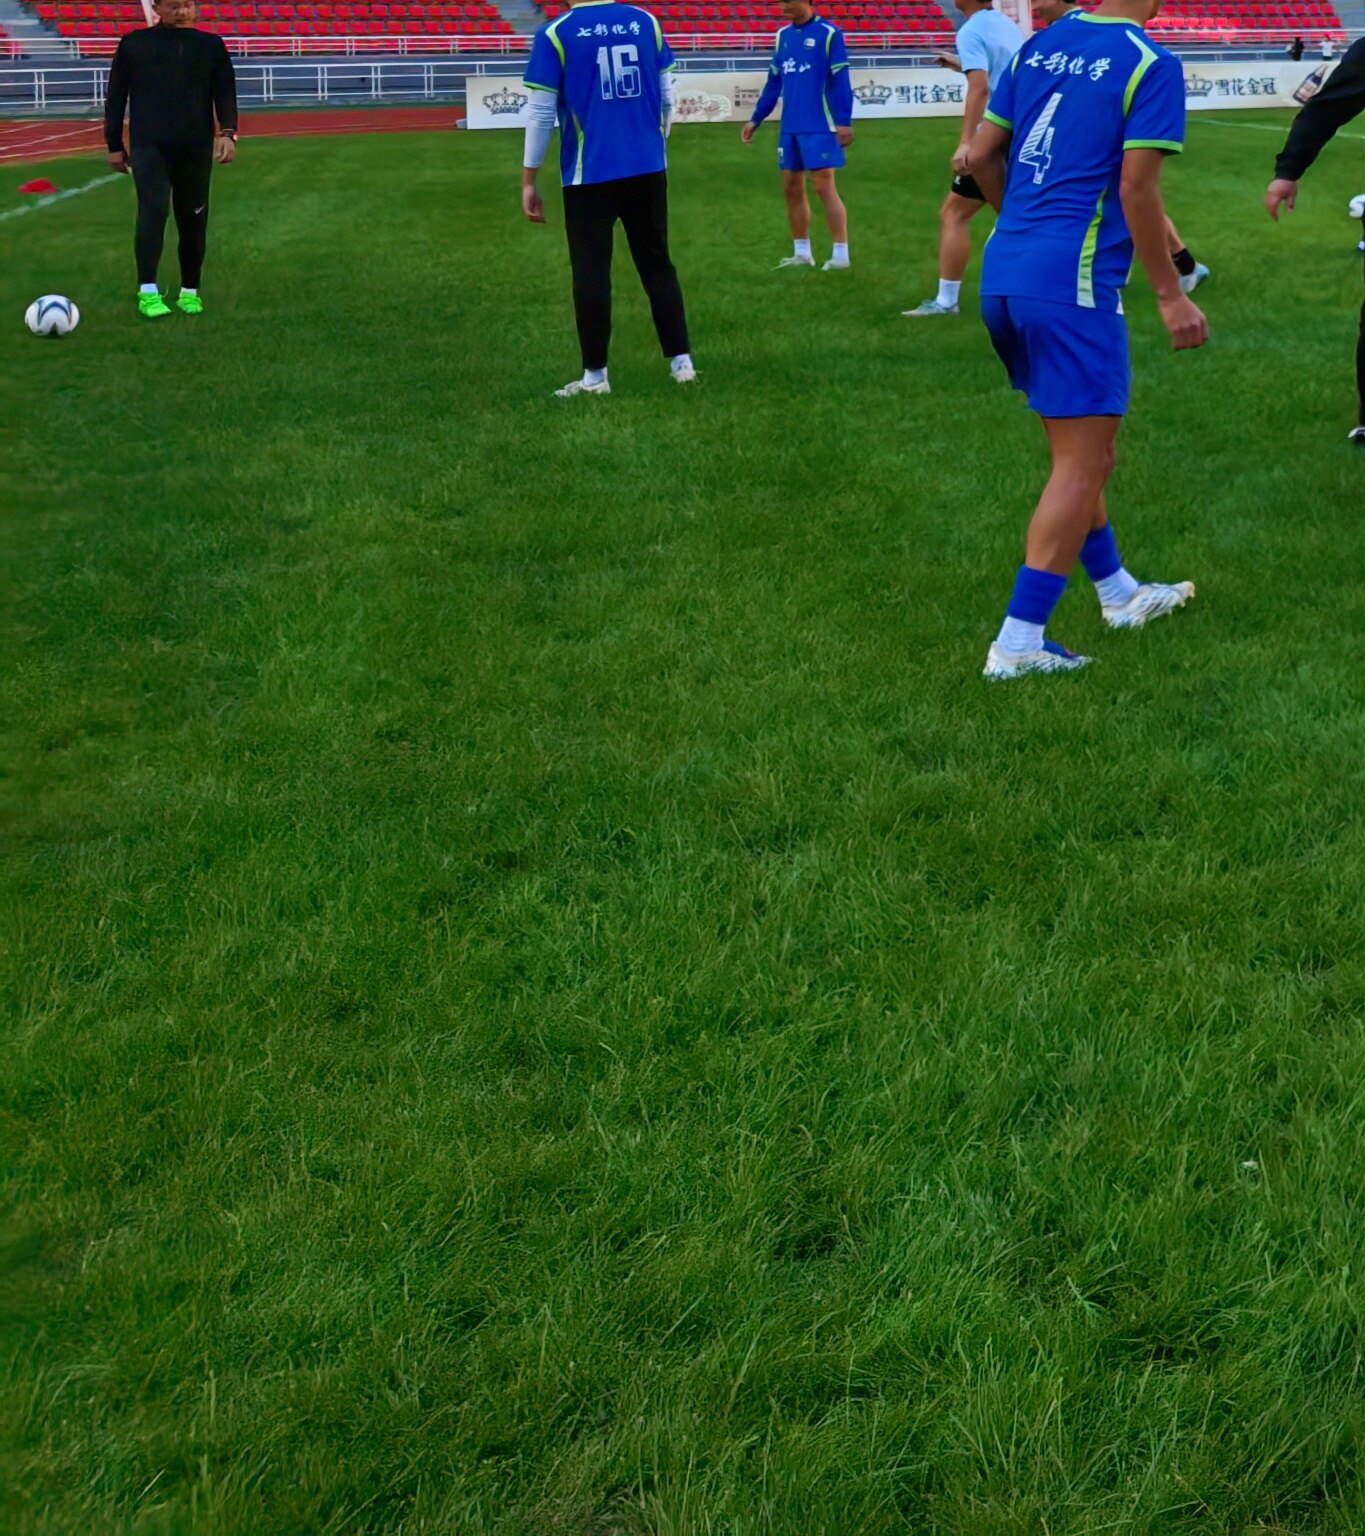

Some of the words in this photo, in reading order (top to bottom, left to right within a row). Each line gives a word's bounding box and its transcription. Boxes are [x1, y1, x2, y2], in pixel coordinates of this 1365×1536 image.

[596, 44, 642, 100] 16
[1025, 50, 1112, 82] 七彩化学
[895, 84, 964, 104] 雪花金冠
[1214, 77, 1278, 96] 雪花金冠
[1018, 91, 1064, 185] 4
